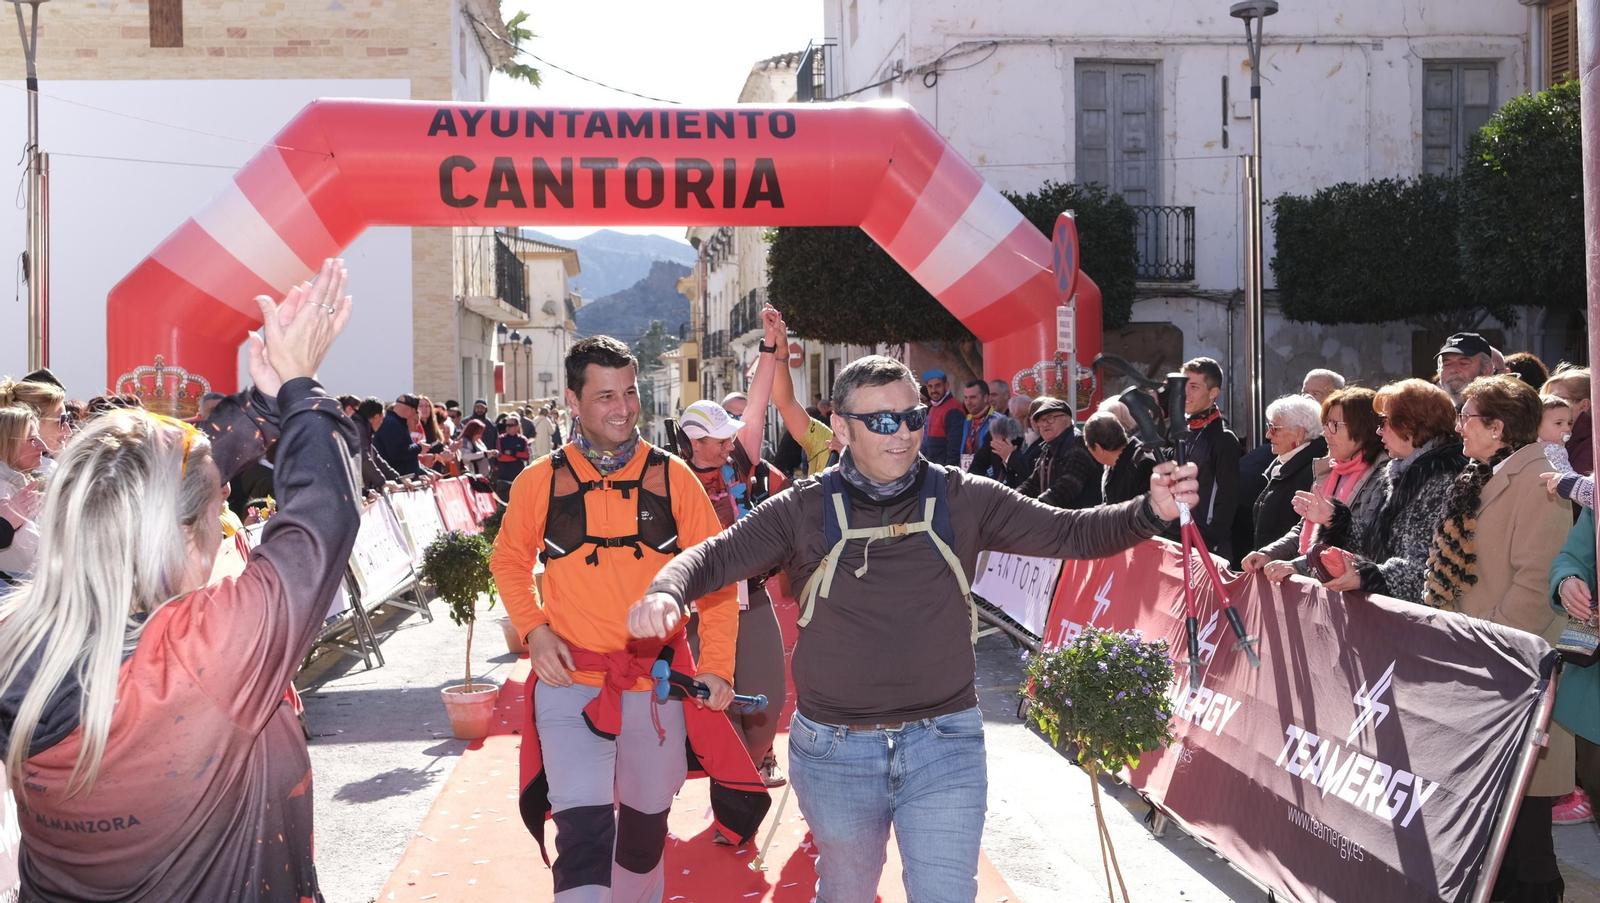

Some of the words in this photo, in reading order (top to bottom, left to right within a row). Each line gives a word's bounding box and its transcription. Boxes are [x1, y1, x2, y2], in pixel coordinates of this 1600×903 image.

[427, 109, 797, 139] AYUNTAMIENTO
[439, 155, 785, 209] CANTORIA
[1275, 723, 1440, 828] TEAMERGY
[36, 814, 142, 834] ALMANZORA
[1287, 804, 1365, 862] www.teamergy.es
